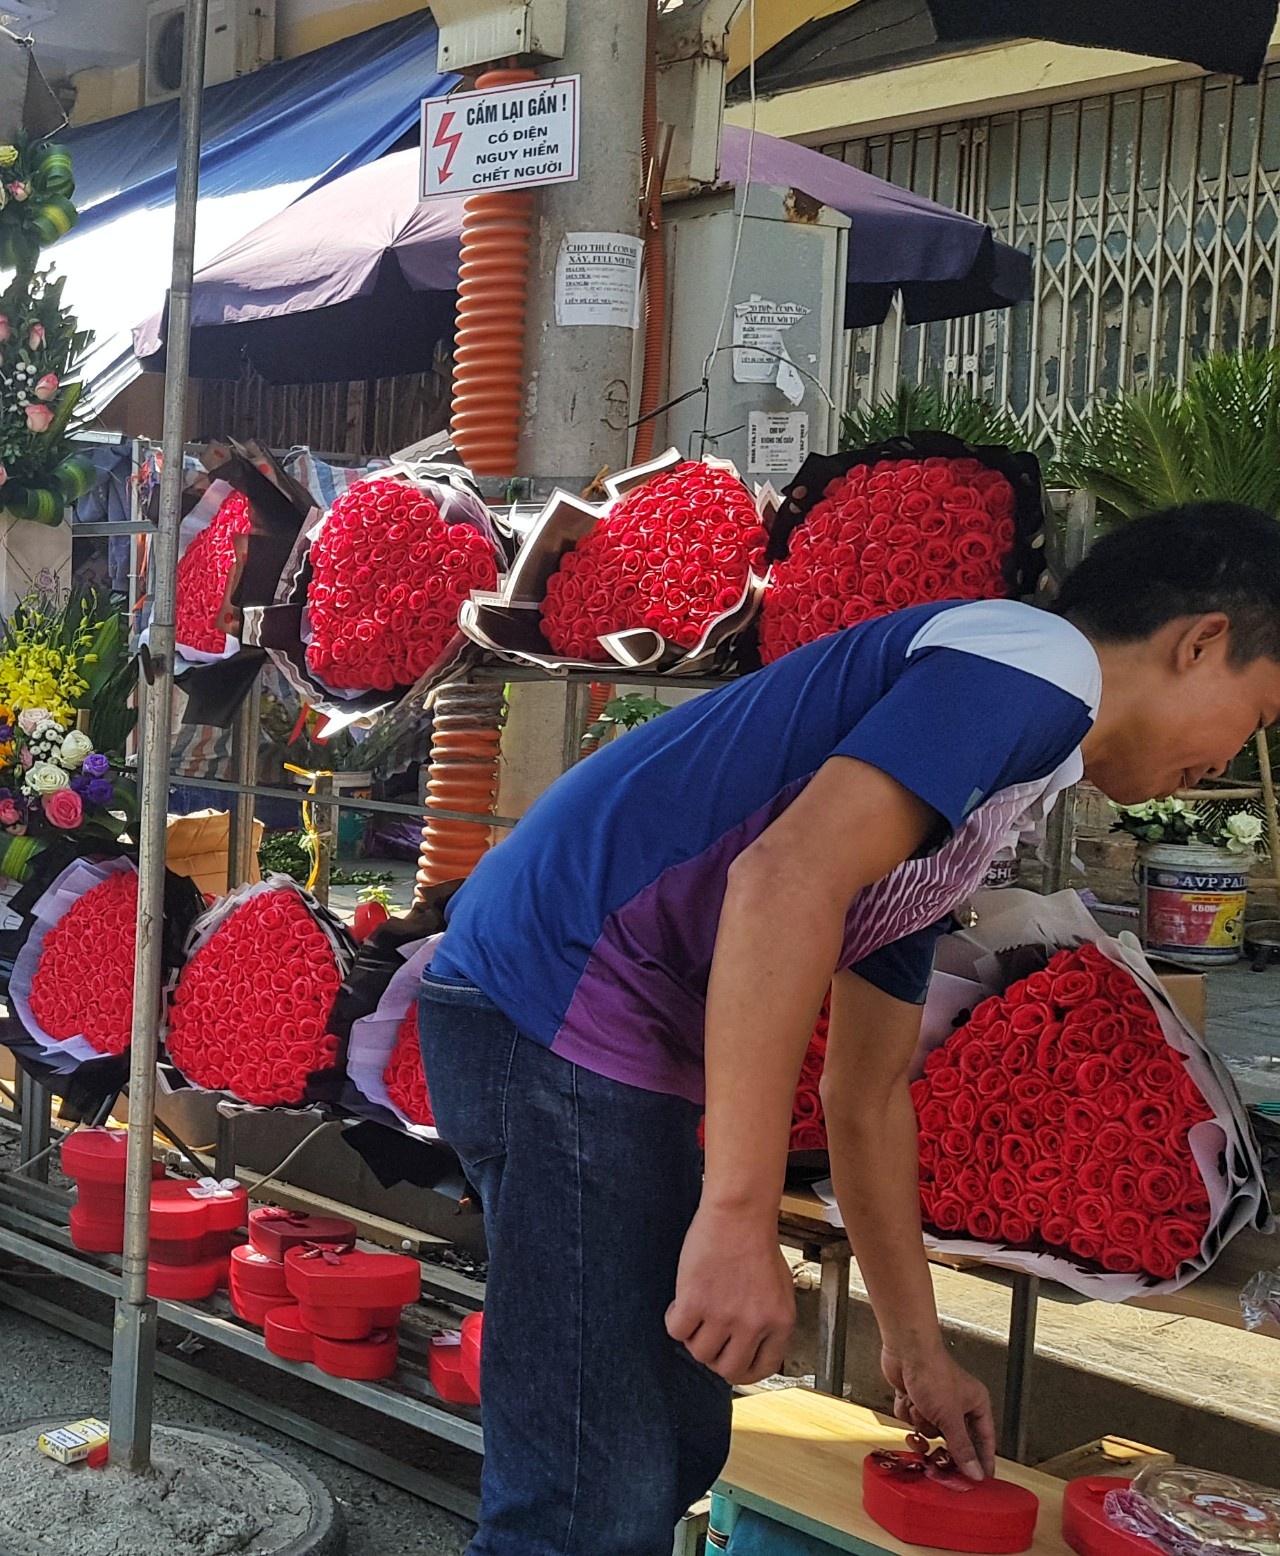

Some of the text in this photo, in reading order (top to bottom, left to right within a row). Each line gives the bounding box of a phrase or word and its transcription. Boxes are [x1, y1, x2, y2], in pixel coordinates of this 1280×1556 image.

[466, 99, 498, 126] CẤM
[502, 100, 524, 124] LẠI
[488, 126, 548, 145] CÓ ĐIỆN
[476, 139, 559, 165] NGUY HIỂM
[472, 161, 562, 184] CHẾT NGƯỜI
[566, 244, 588, 252] CHO
[588, 242, 611, 252] THUÊ
[592, 255, 613, 263] FULL
[1181, 876, 1218, 888] AVP
